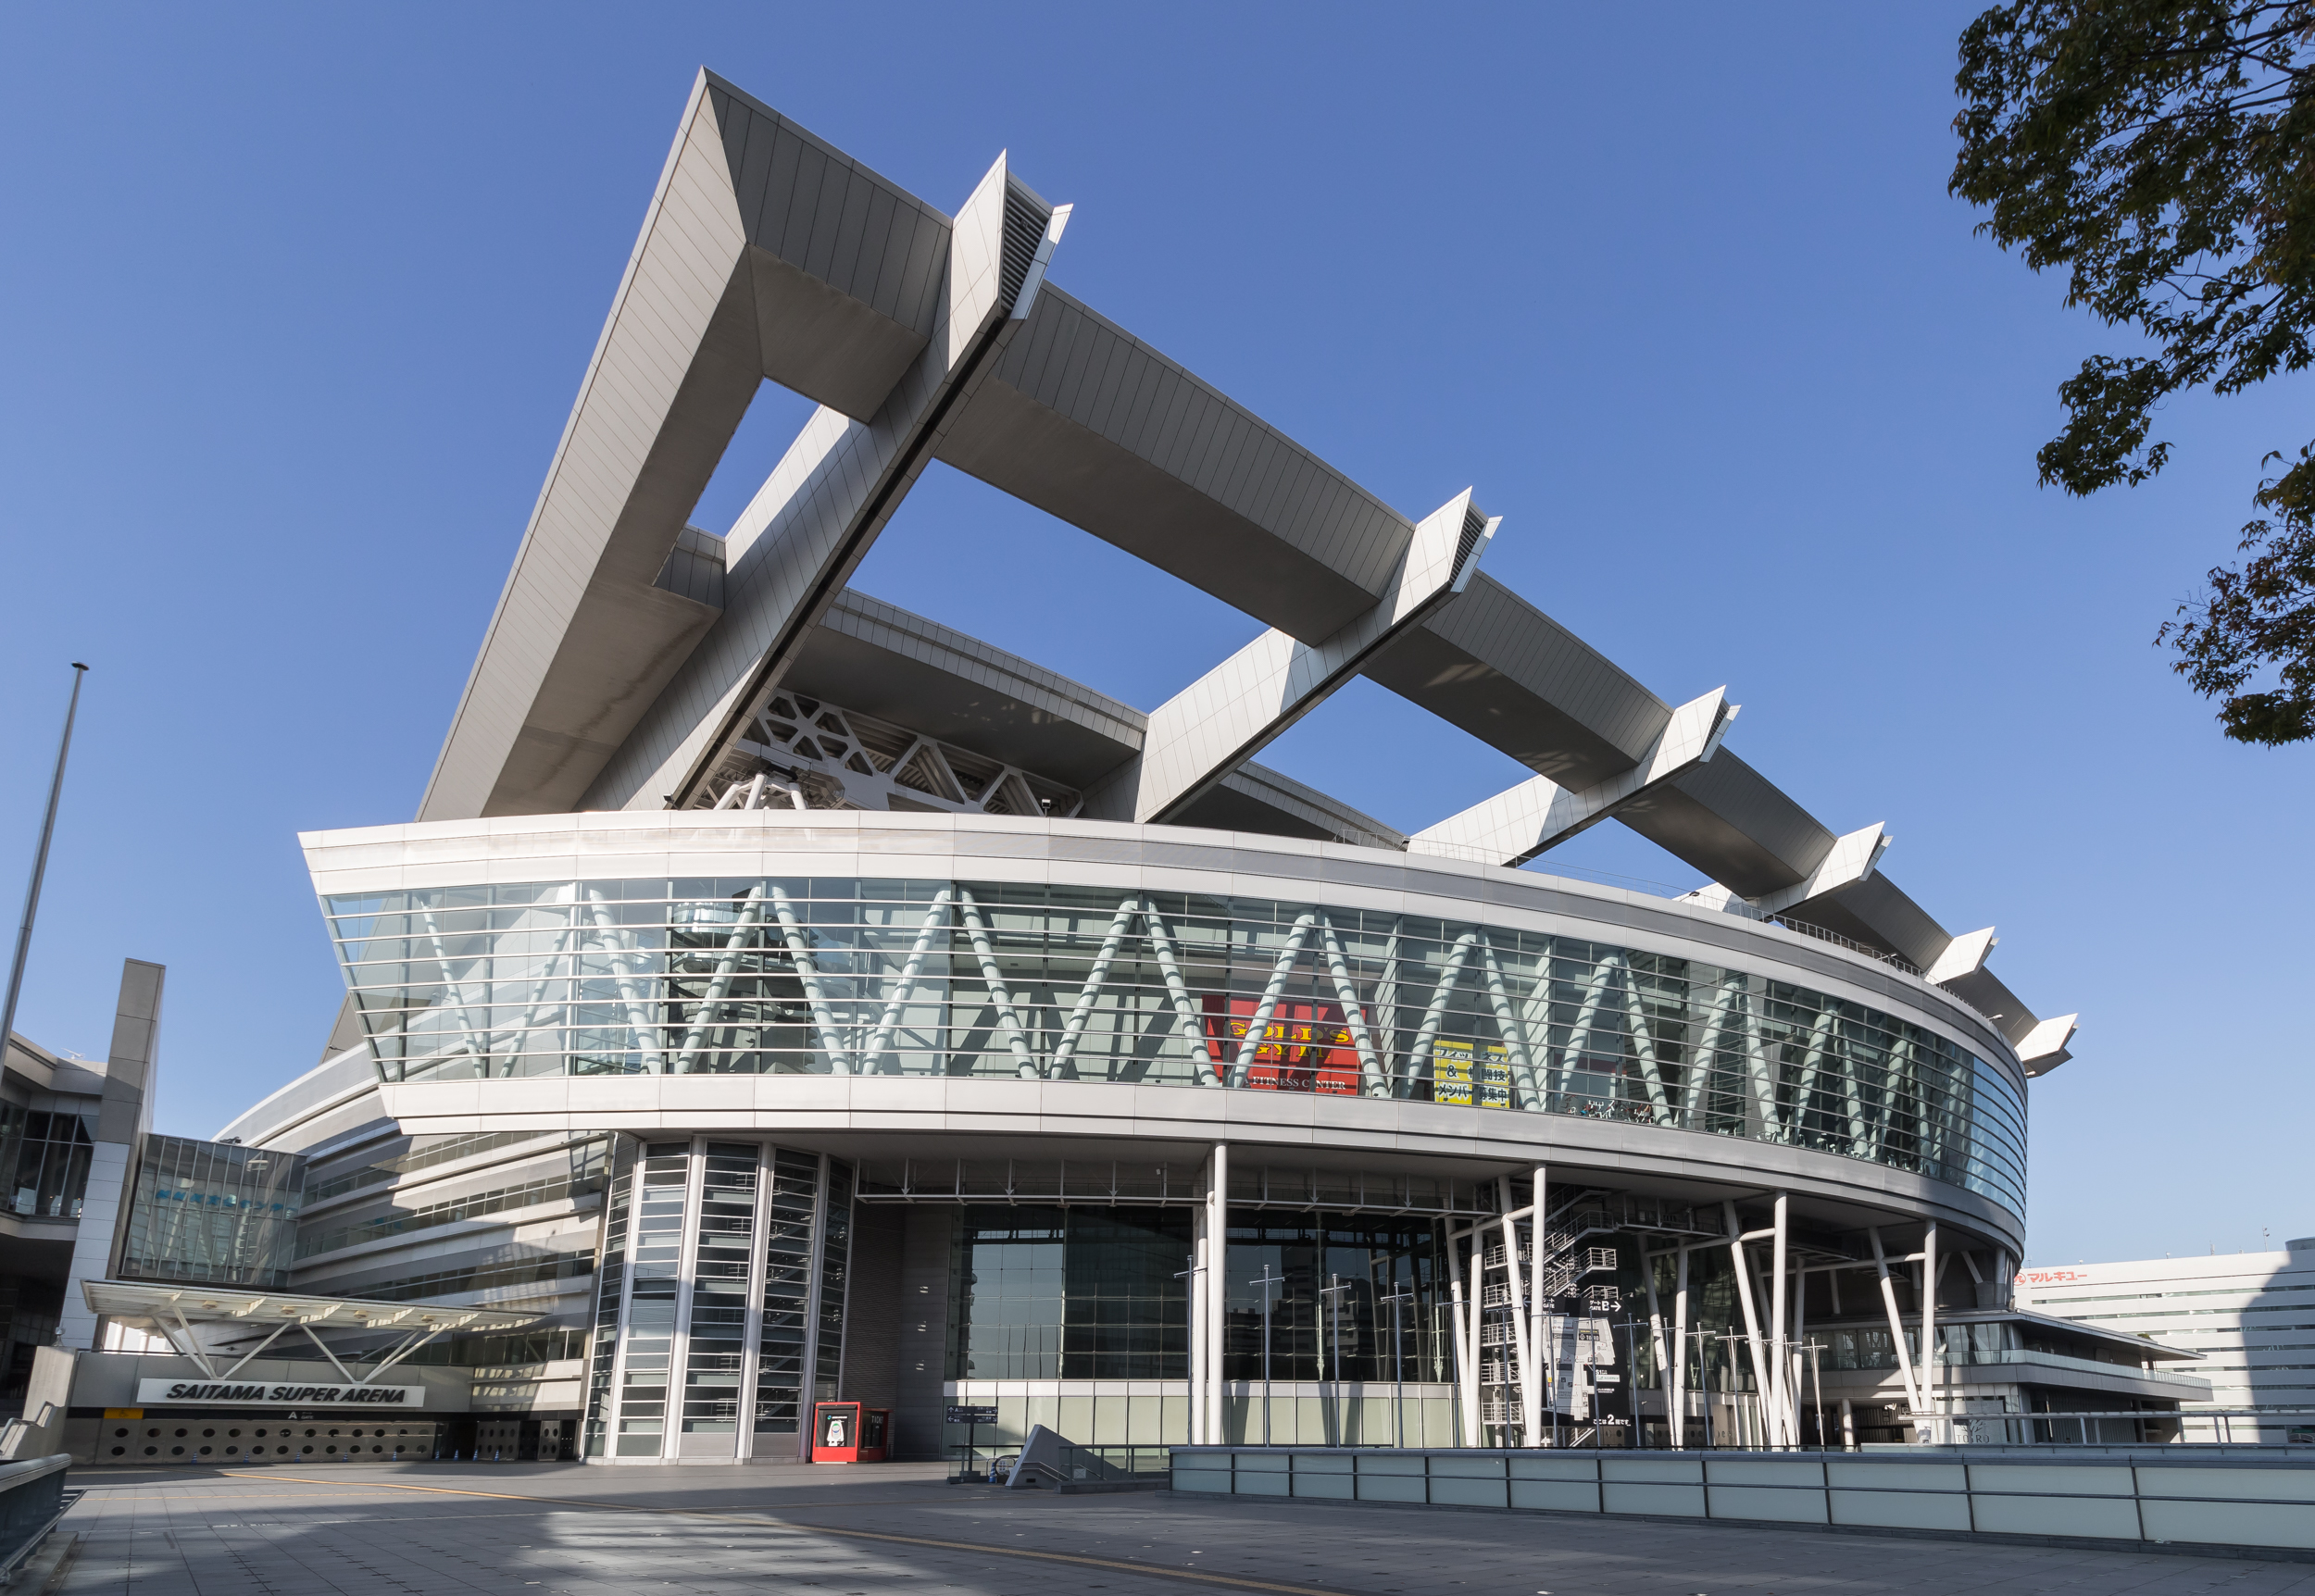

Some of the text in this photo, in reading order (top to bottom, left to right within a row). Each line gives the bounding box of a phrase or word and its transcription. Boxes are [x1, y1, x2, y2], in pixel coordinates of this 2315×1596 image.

[1436, 1048, 1505, 1063] フィッネス
[1446, 1065, 1457, 1078] &
[1253, 1076, 1299, 1088] FITNESS
[1302, 1079, 1346, 1091] CNTER
[2027, 1271, 2088, 1283] マルキュー
[1601, 1300, 1610, 1312] B
[167, 1383, 407, 1403] SAITAMA SUPER ARENA
[288, 1411, 297, 1419] A
